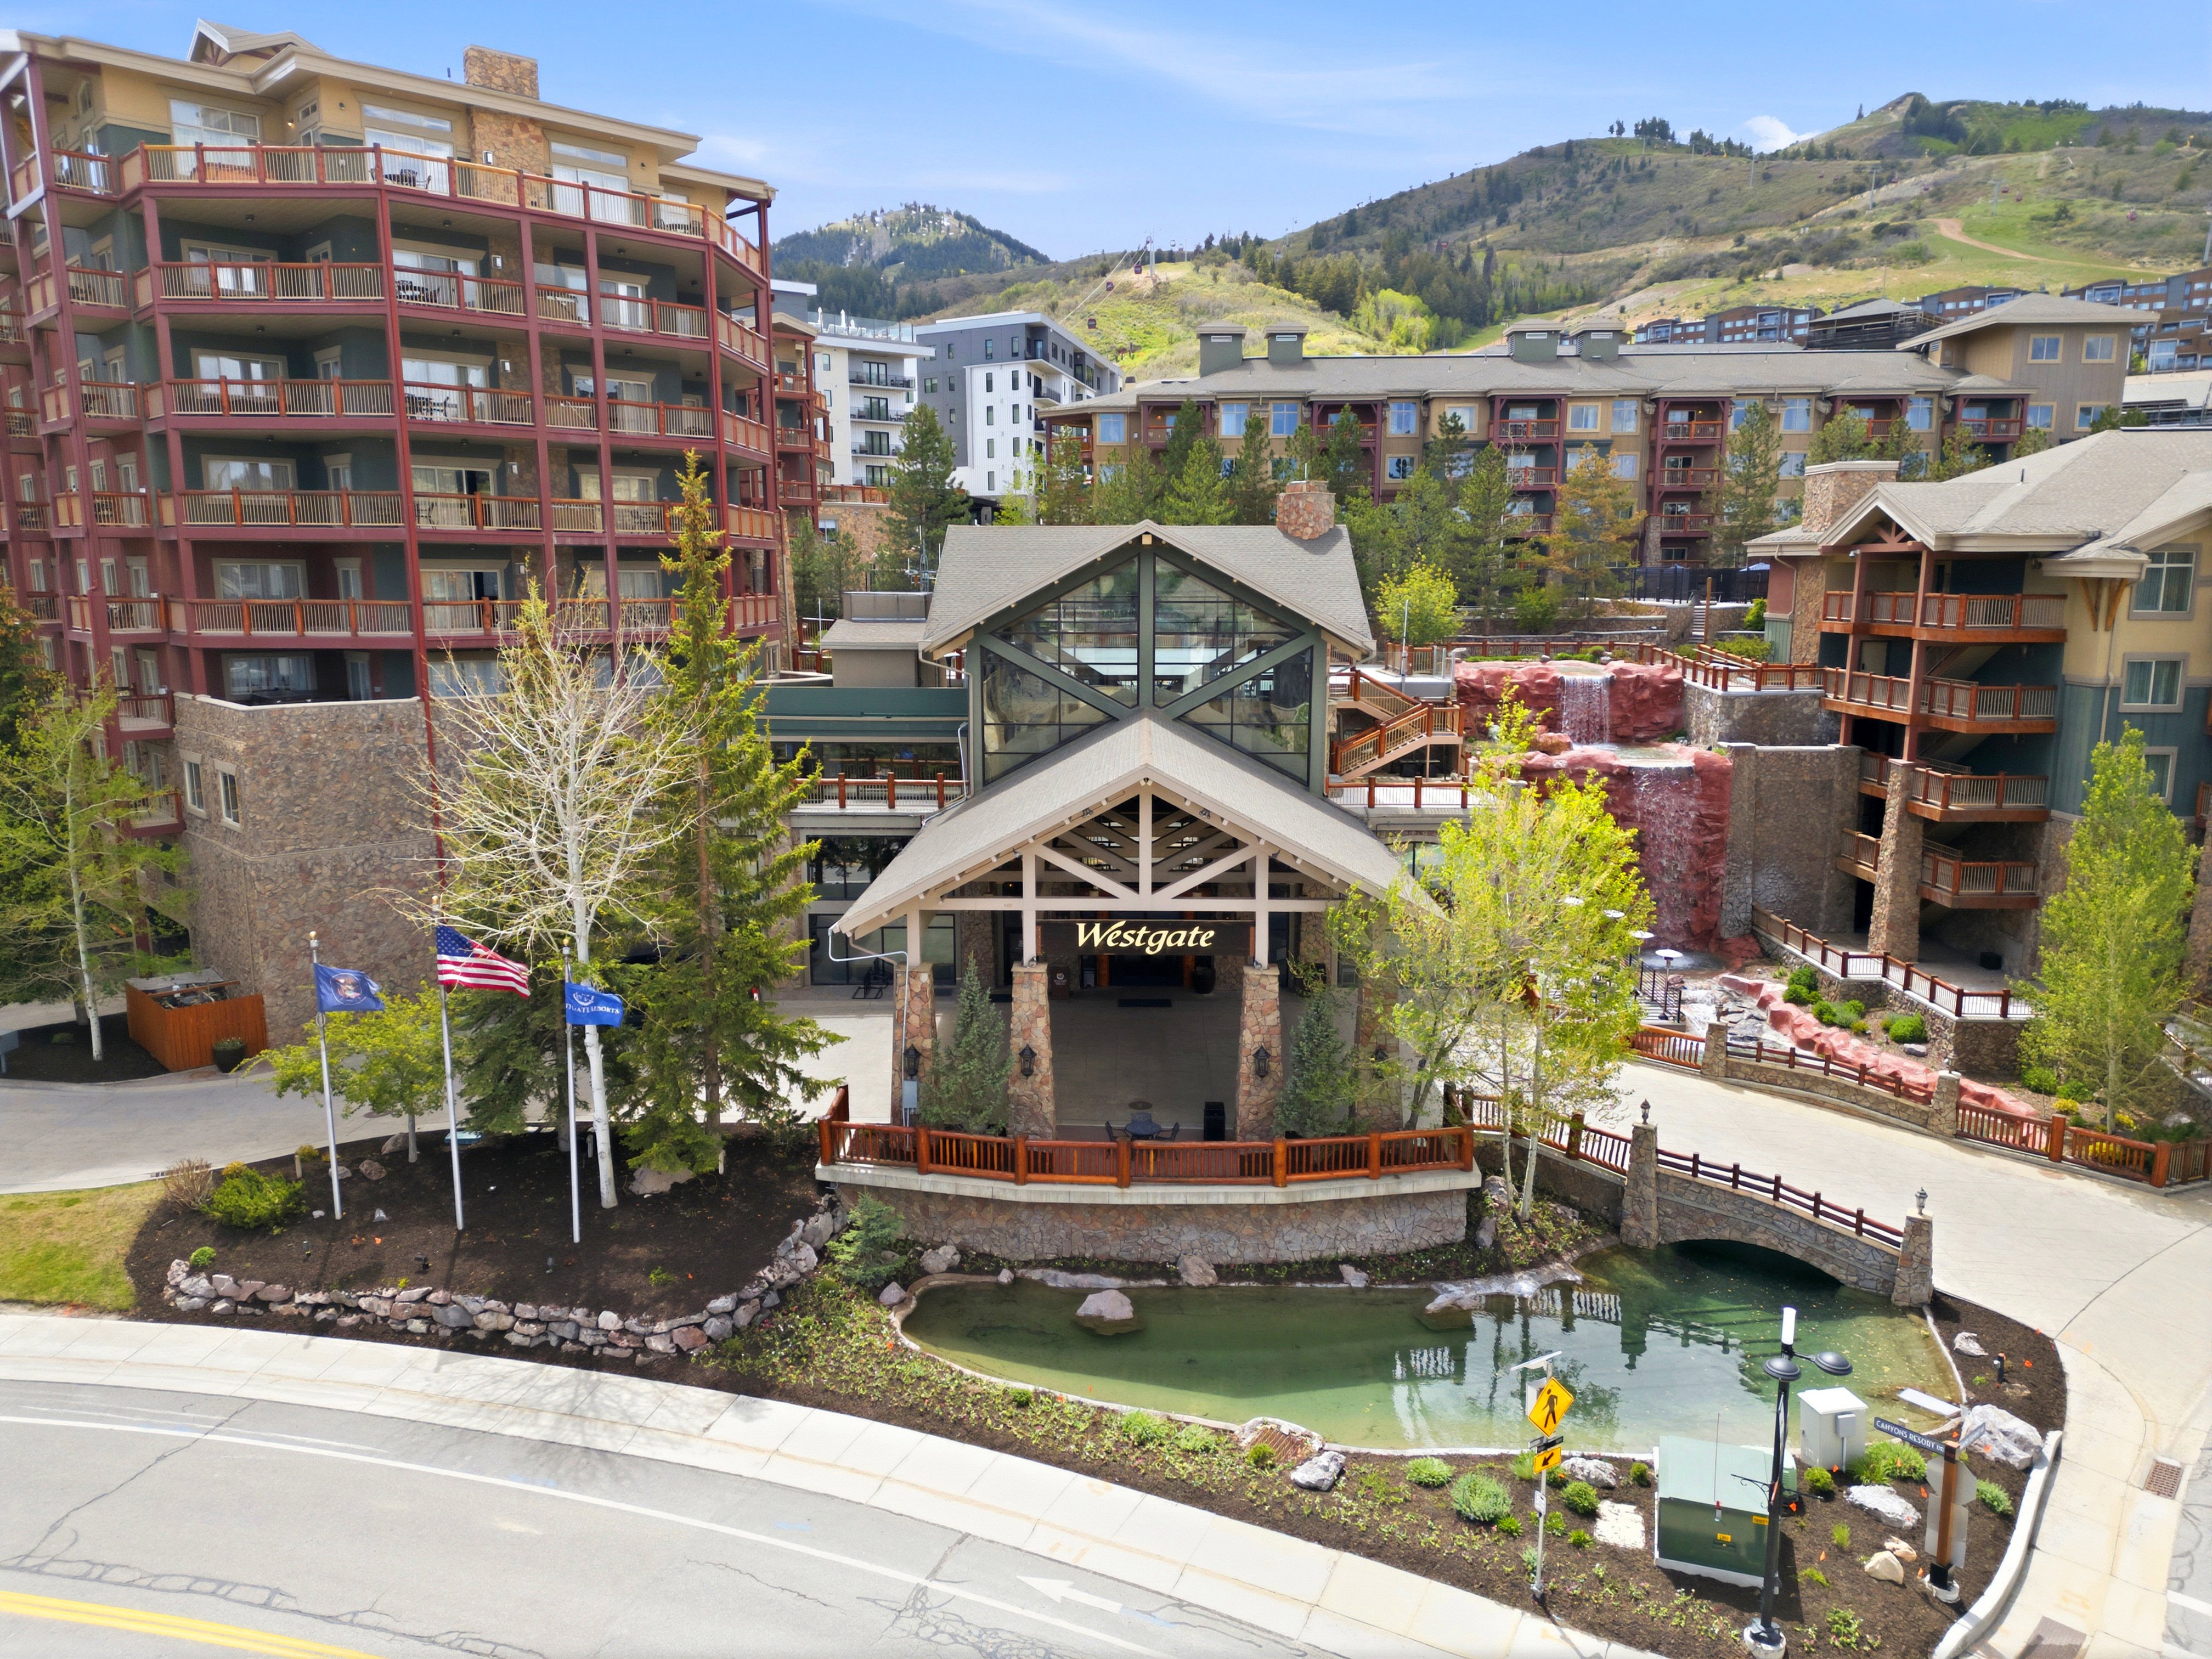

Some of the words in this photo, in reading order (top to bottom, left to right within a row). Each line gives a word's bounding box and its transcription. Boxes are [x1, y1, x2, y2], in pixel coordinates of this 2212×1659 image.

[1076, 921, 1215, 955] Westgate
[1876, 1420, 1908, 1438] CANYONS
[1909, 1433, 1936, 1448] RESORT
